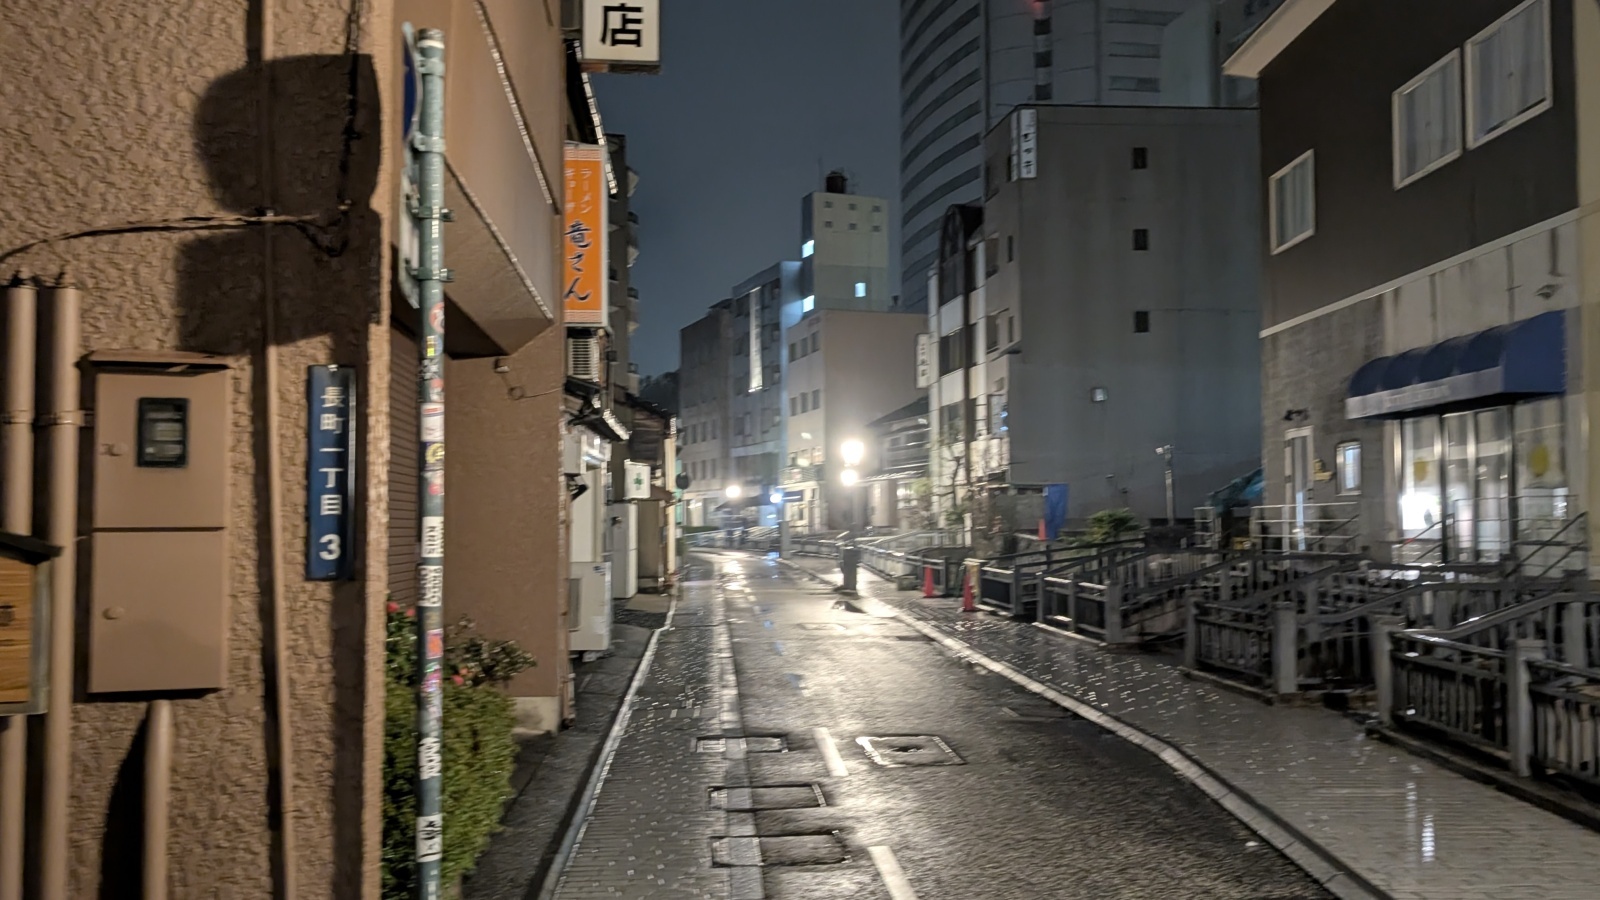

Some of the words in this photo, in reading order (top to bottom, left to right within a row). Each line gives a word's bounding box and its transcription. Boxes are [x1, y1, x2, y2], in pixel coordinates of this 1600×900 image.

[600, 3, 643, 47] 店
[580, 168, 593, 214] ラーメン
[564, 219, 592, 301] 竜さん
